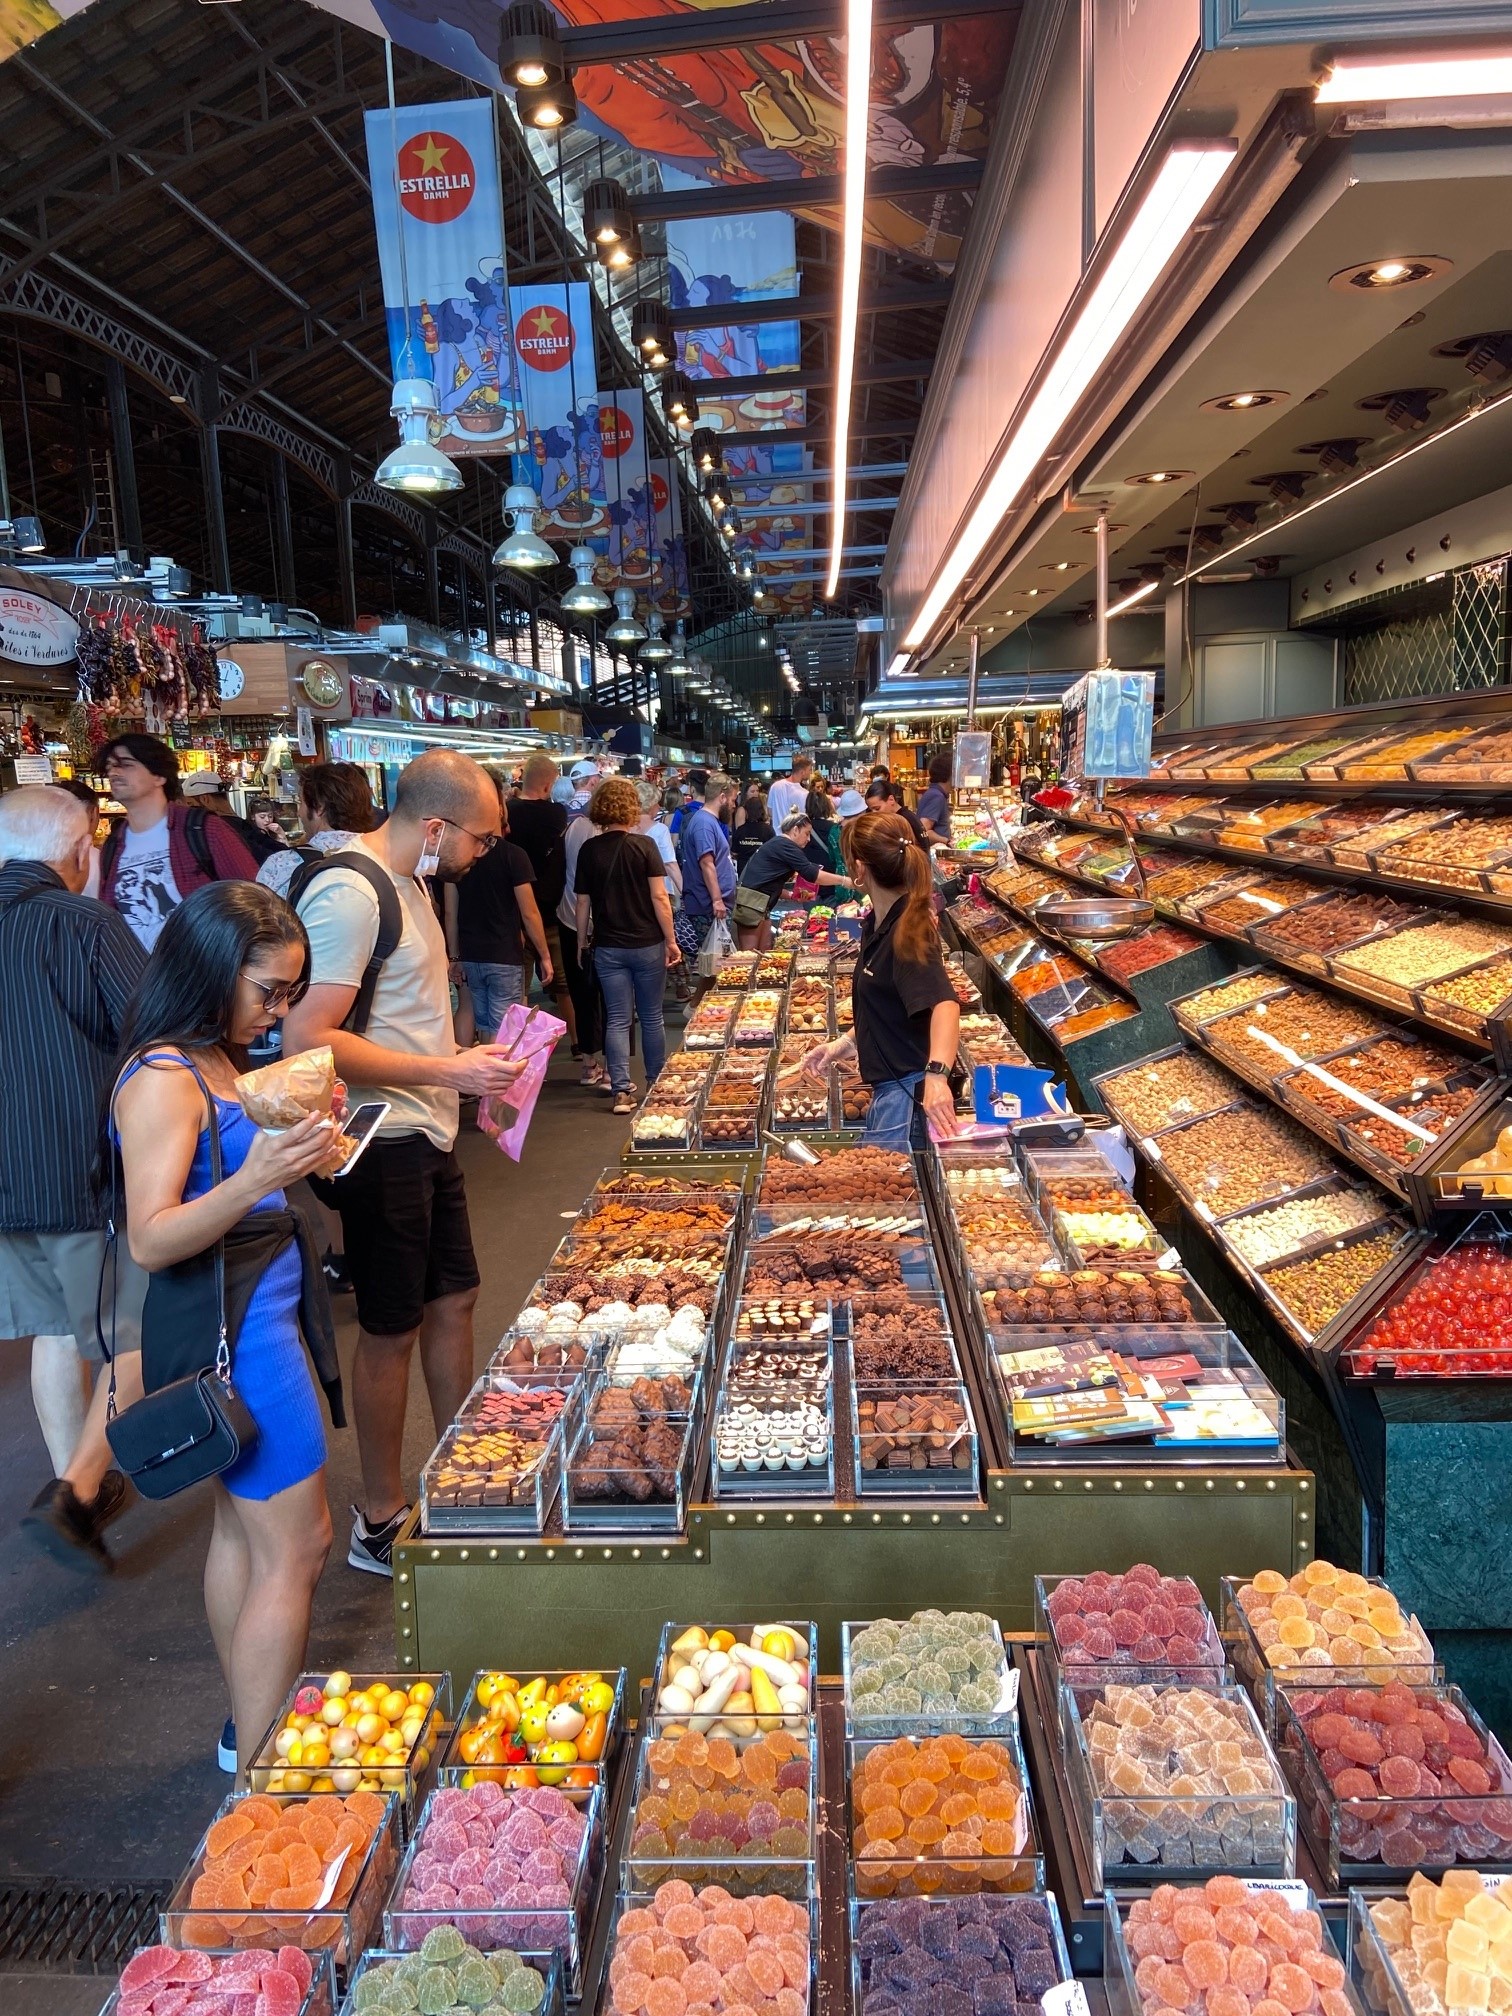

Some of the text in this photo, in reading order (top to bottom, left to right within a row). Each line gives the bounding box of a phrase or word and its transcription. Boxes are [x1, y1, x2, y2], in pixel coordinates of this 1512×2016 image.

[400, 173, 471, 194] ESTRELLA
[423, 190, 450, 200] DAMM
[600, 430, 632, 441] TRELA
[2, 598, 42, 615] SOLEY
[31, 644, 68, 659] Verdures
